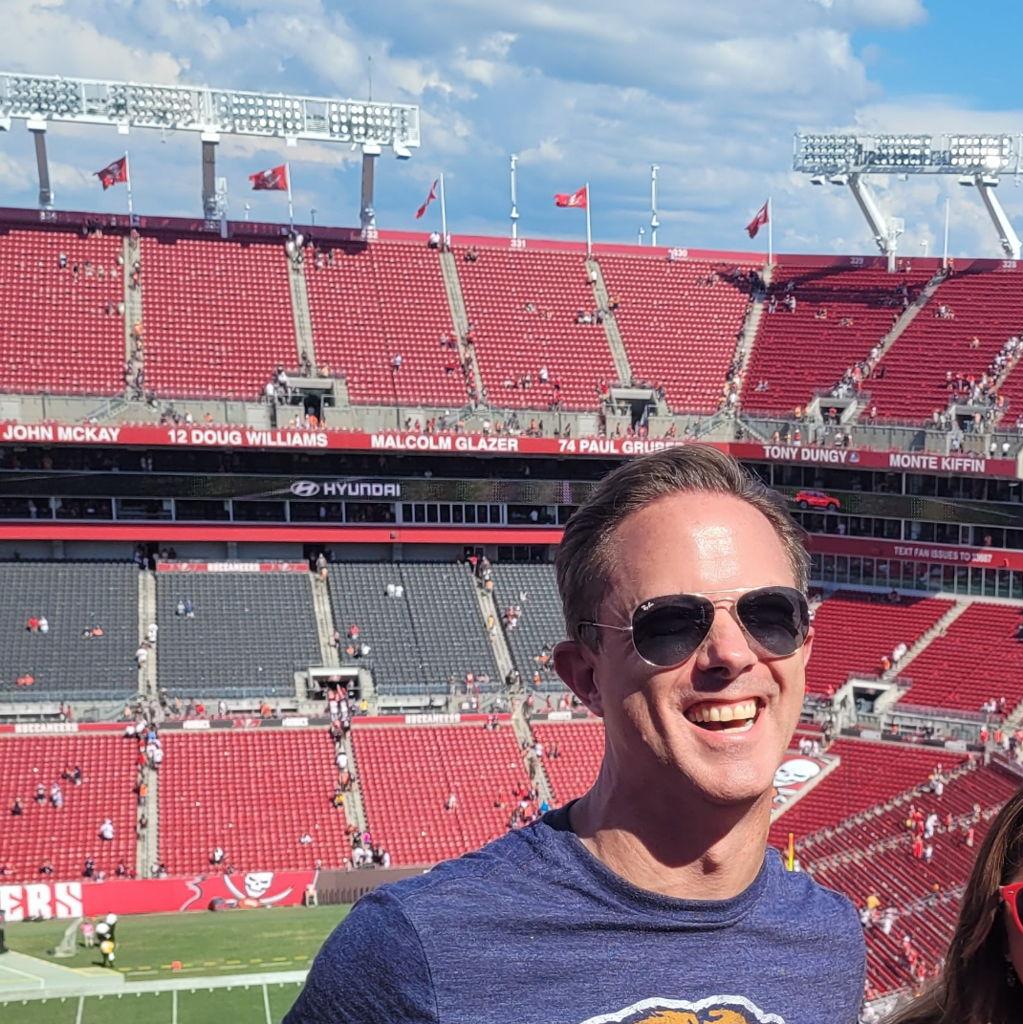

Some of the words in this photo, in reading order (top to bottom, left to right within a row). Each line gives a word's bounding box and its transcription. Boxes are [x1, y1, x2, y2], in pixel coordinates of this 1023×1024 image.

[3, 425, 54, 440] JOHN
[58, 426, 120, 441] MCKAY
[168, 429, 187, 444] 12
[192, 430, 241, 445] DOUG
[246, 431, 328, 448] WILLIAMS
[371, 434, 451, 451] MALCOLM
[455, 437, 519, 452] GLAZER
[558, 439, 576, 452] 74
[580, 440, 619, 454] PAUL
[764, 446, 799, 461] TONY
[801, 447, 848, 464] DUNGY
[889, 453, 938, 471] MONTE
[941, 456, 986, 473] KIFFIN
[323, 483, 400, 498] HYUNDAI
[894, 546, 914, 556] TEXT
[914, 548, 930, 558] FAN
[930, 549, 958, 560] ISSUES
[960, 551, 971, 561] TO
[0, 883, 82, 922] ERS
